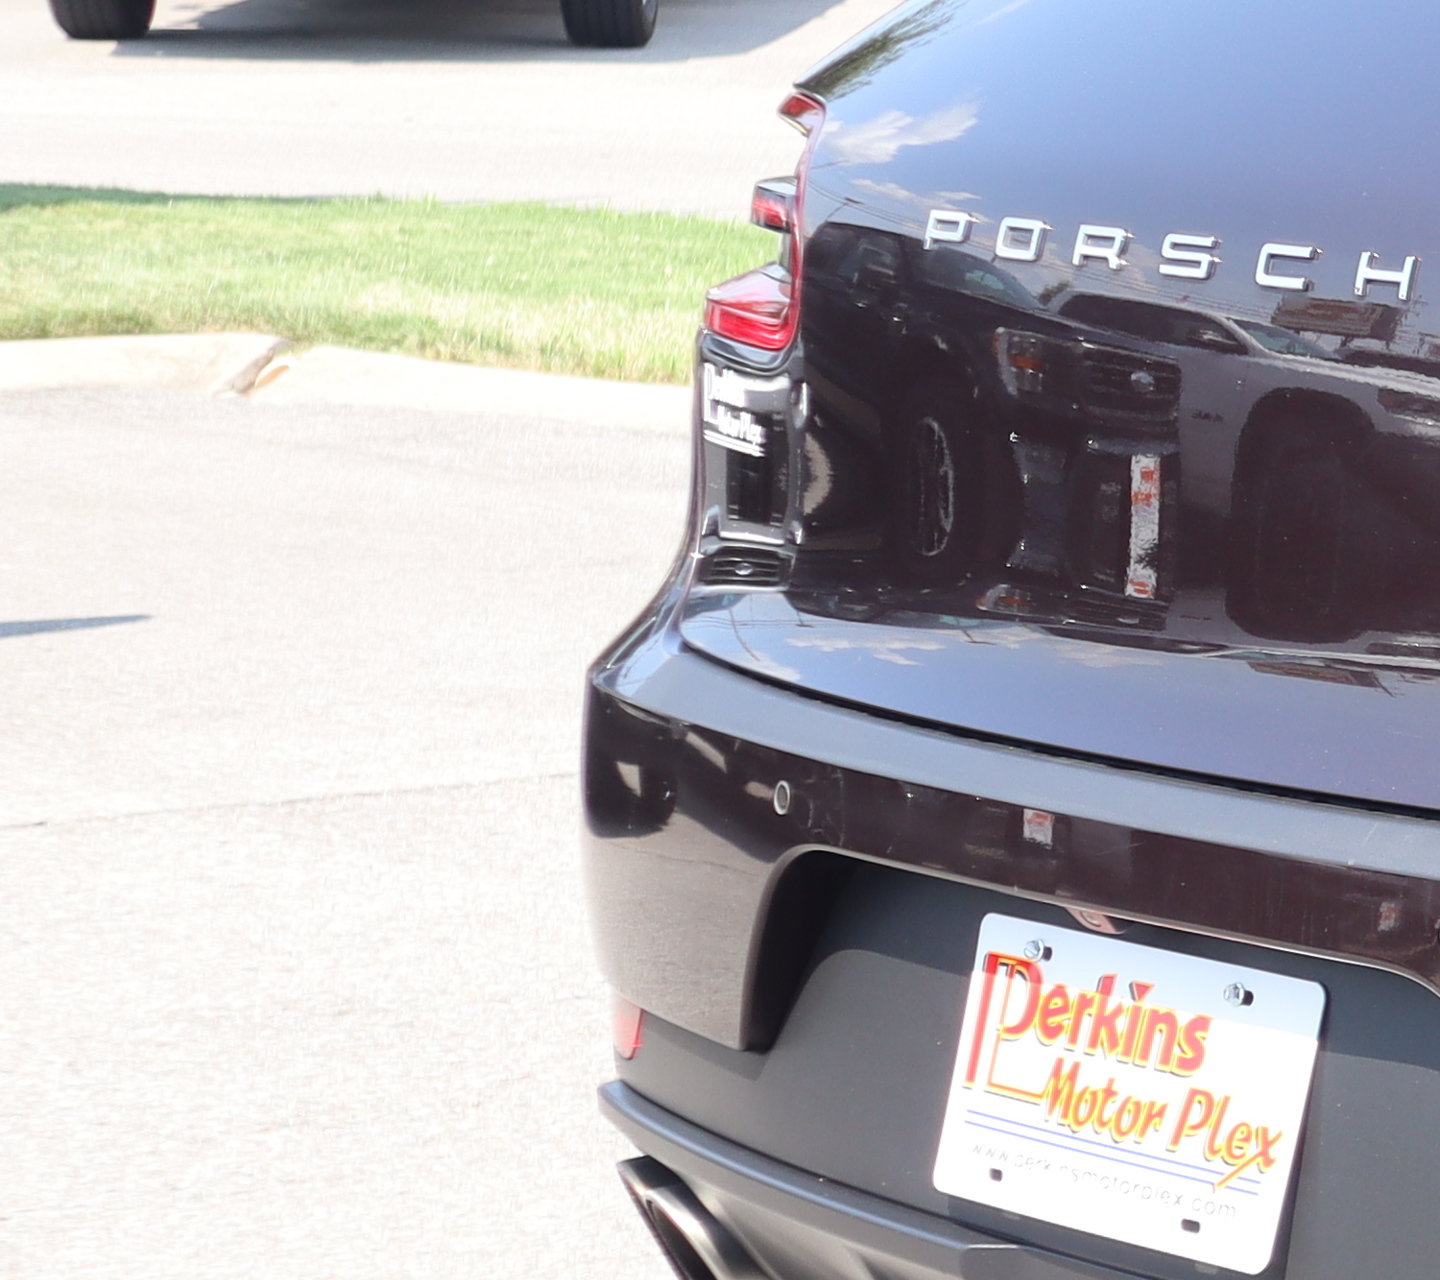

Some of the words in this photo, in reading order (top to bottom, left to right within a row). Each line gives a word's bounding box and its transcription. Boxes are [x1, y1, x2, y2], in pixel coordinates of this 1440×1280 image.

[963, 951, 1214, 1090] Perkins
[1044, 1057, 1167, 1138] Motor
[1166, 1087, 1283, 1190] Plex
